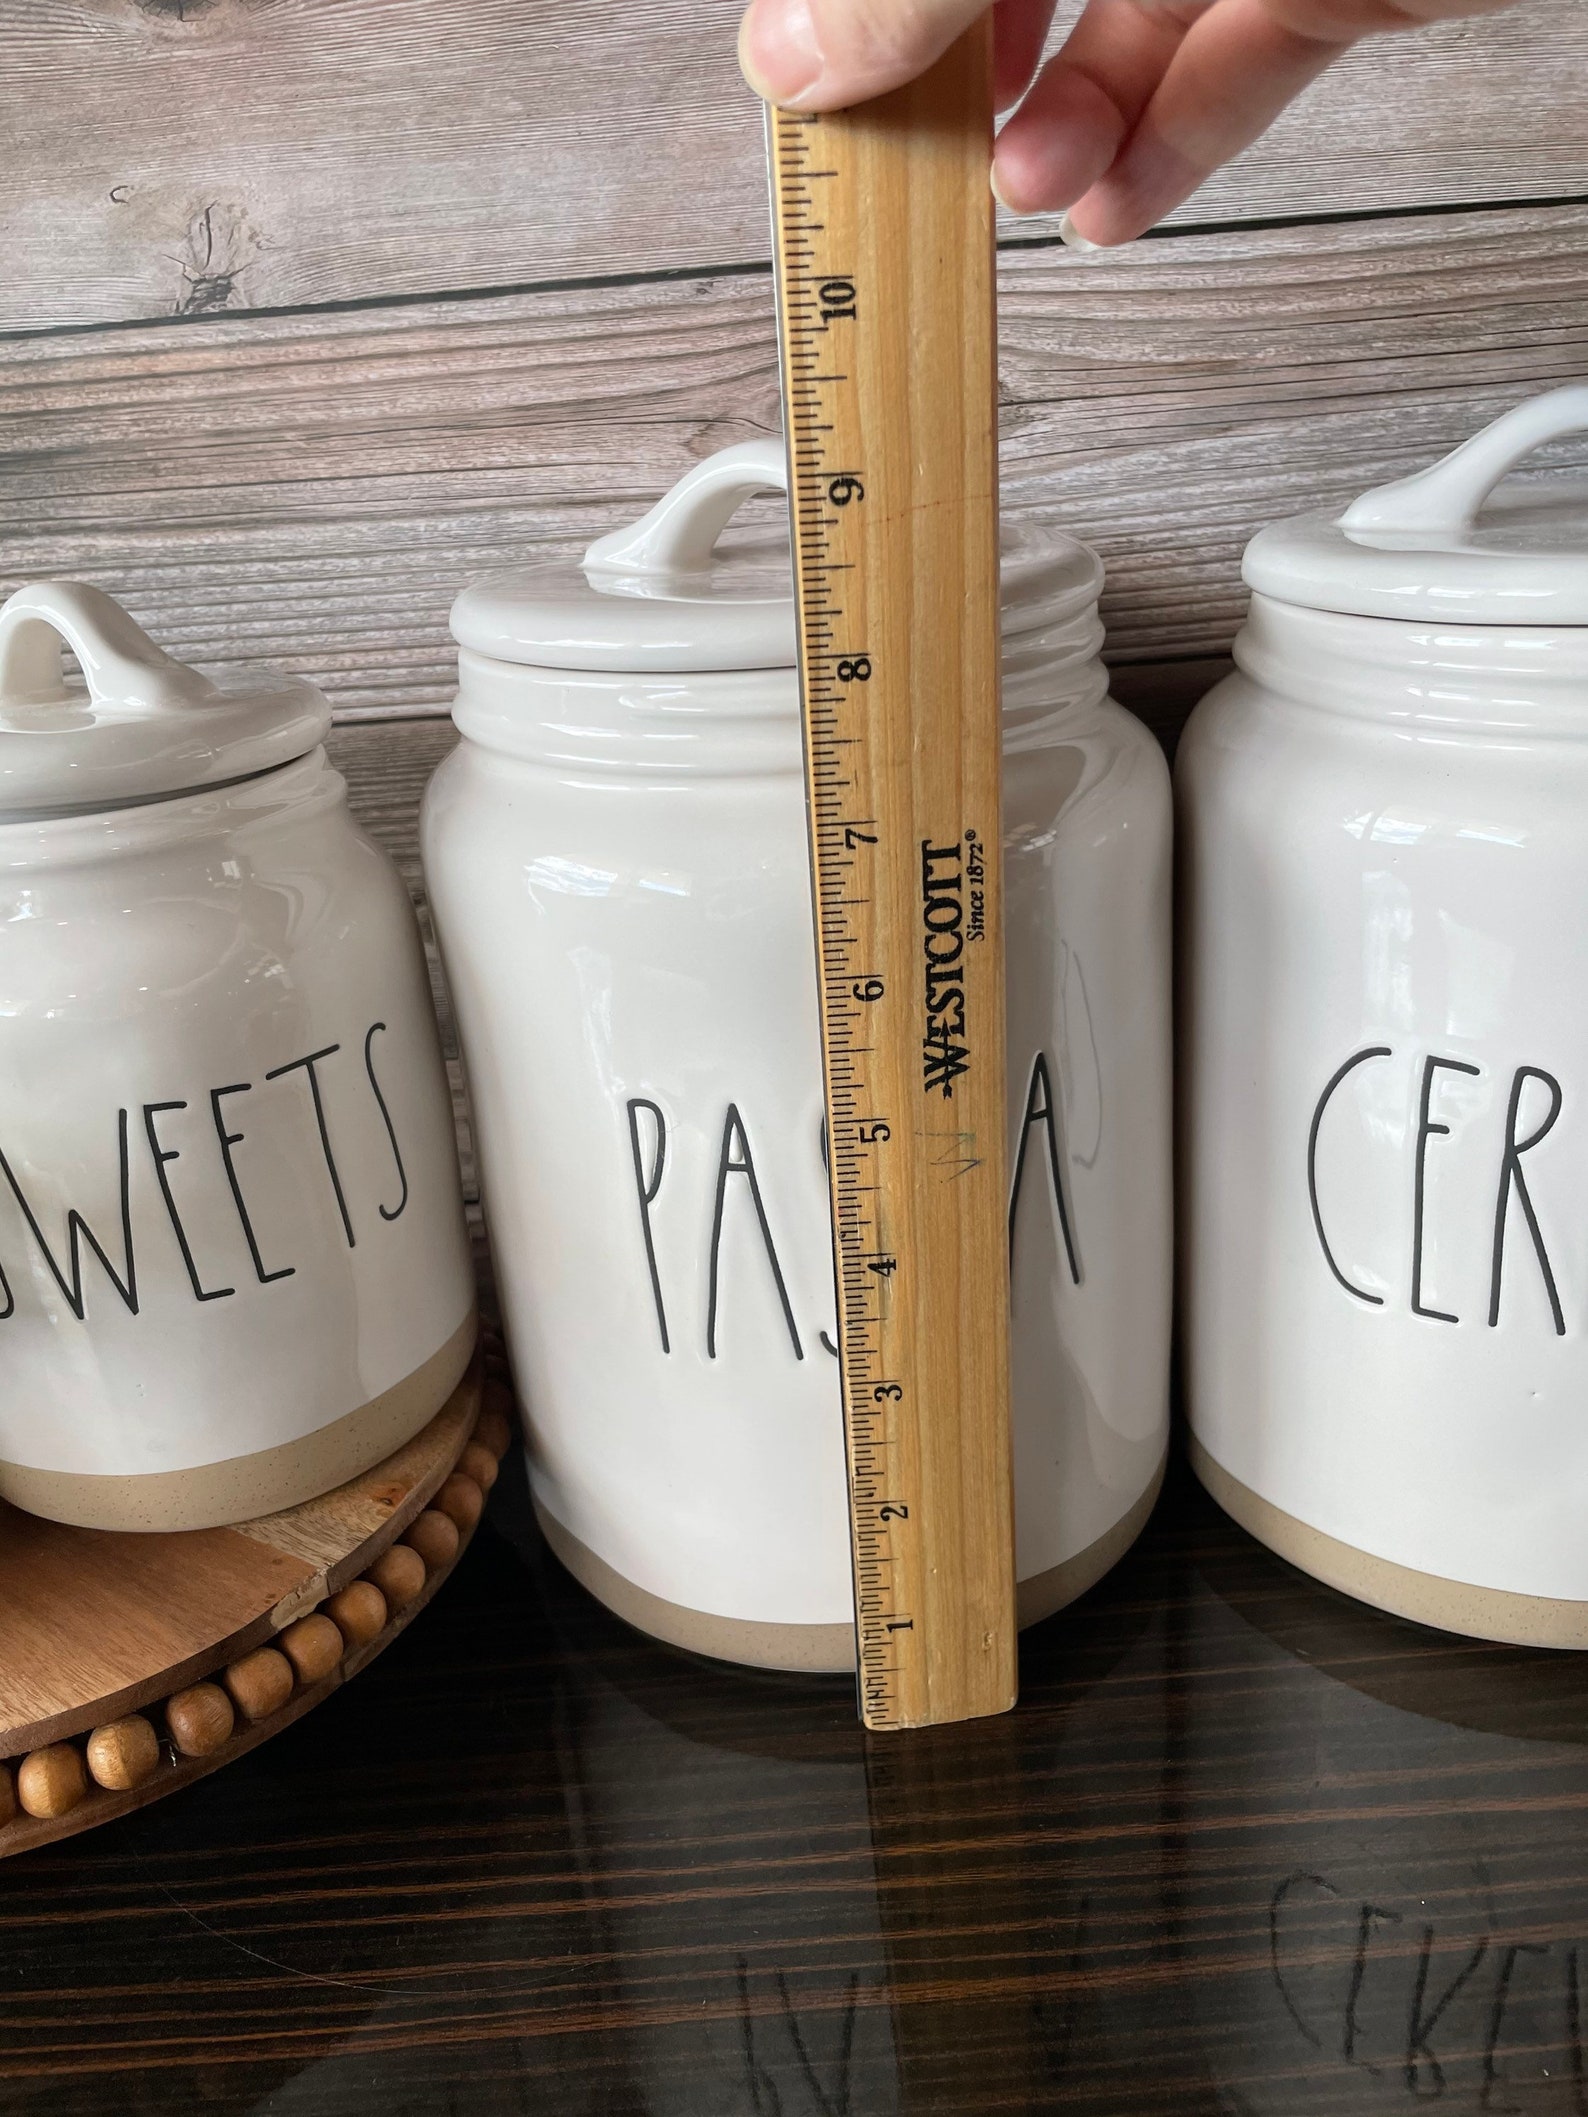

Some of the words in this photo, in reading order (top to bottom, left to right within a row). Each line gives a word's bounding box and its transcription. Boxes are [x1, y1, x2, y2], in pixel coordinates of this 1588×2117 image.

[819, 281, 857, 321] 10
[828, 477, 864, 507] 9
[836, 657, 872, 683] 8
[845, 828, 878, 850] 7
[966, 890, 985, 942] Since
[921, 839, 971, 1098] WESTCOTT
[852, 979, 885, 1002] 6
[859, 1122, 891, 1144] 5
[0, 1021, 408, 1320] WEETS
[1307, 1046, 1567, 1336] CER
[627, 1050, 1080, 1360] PAA
[867, 1257, 897, 1278] 4
[873, 1383, 903, 1403] 3
[879, 1503, 908, 1522] 2
[886, 1617, 914, 1635] 1
